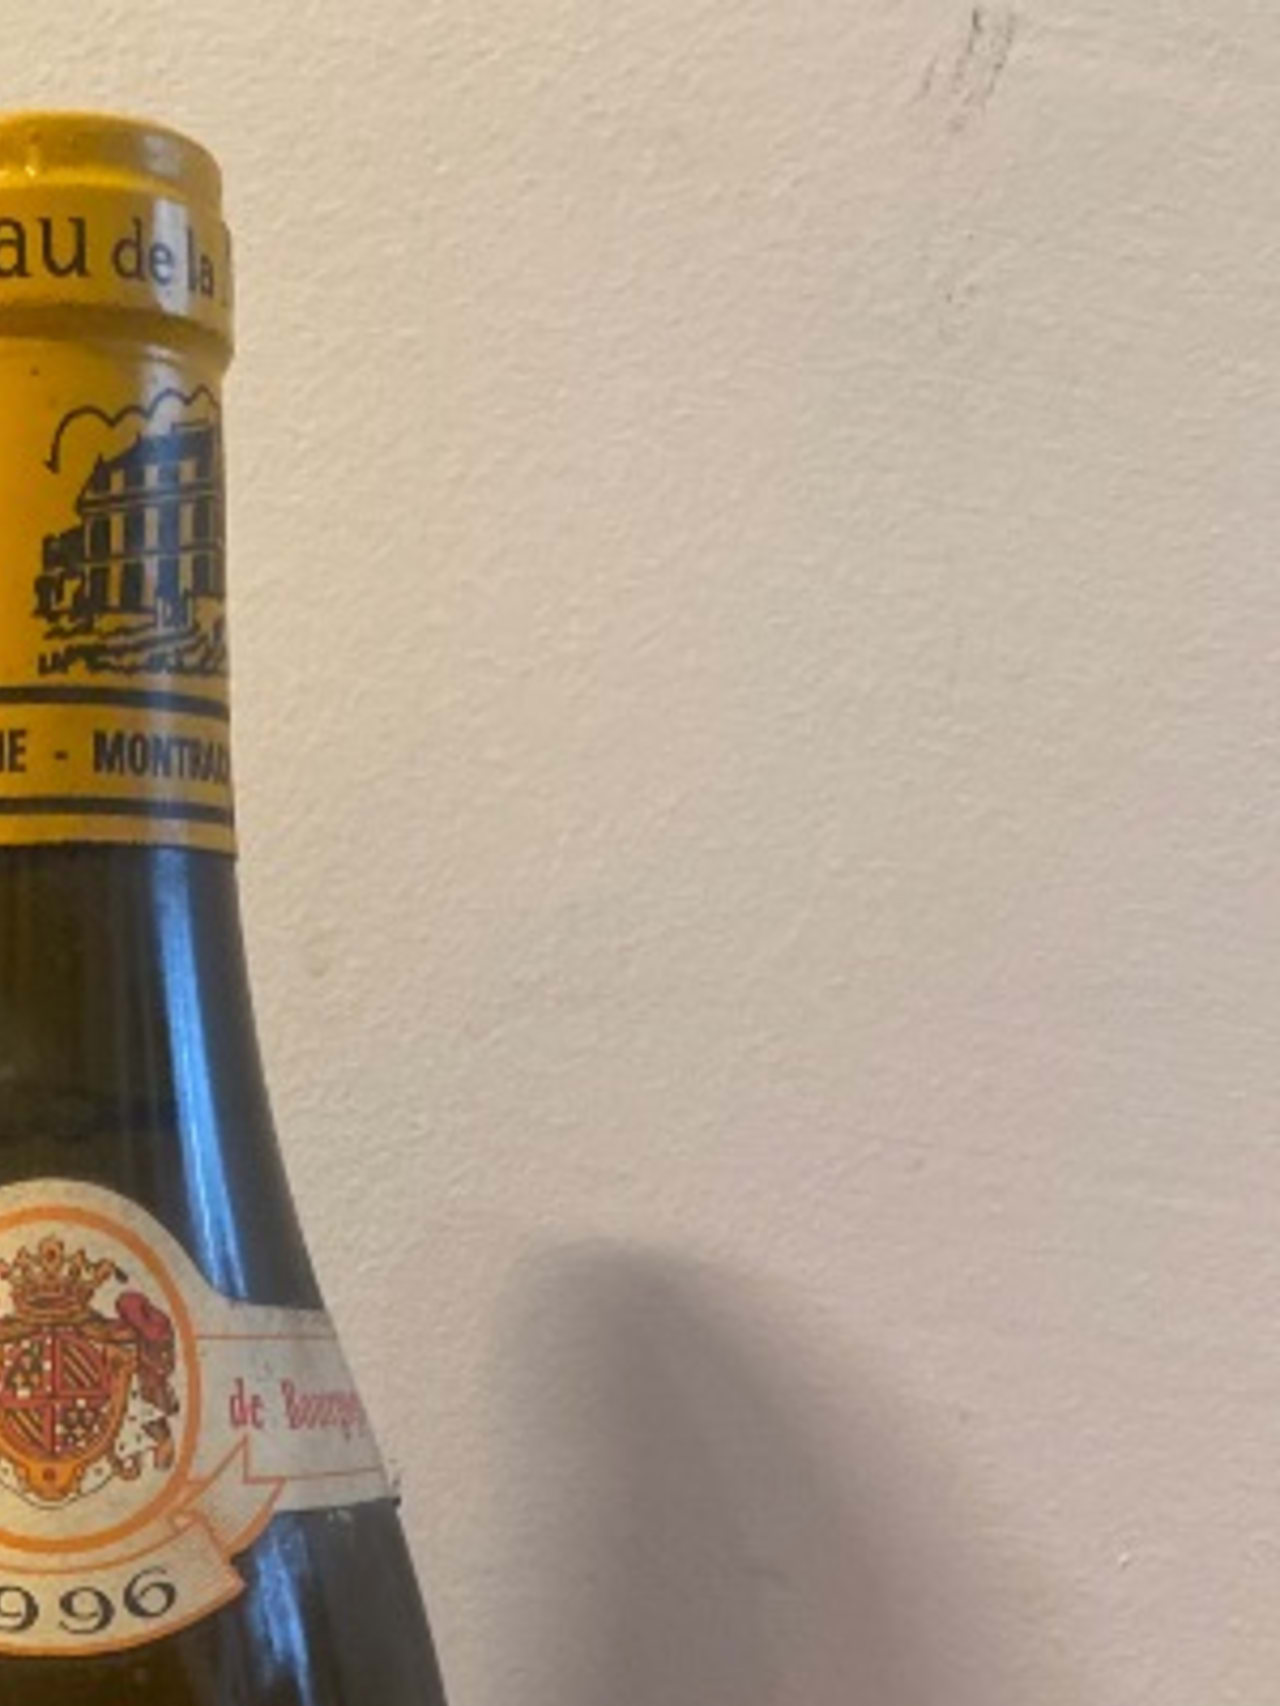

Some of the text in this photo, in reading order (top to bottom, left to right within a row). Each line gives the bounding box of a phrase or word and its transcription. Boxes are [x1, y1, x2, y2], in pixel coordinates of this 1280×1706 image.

[111, 217, 176, 285] de
[187, 228, 216, 299] la
[229, 1376, 264, 1431] de
